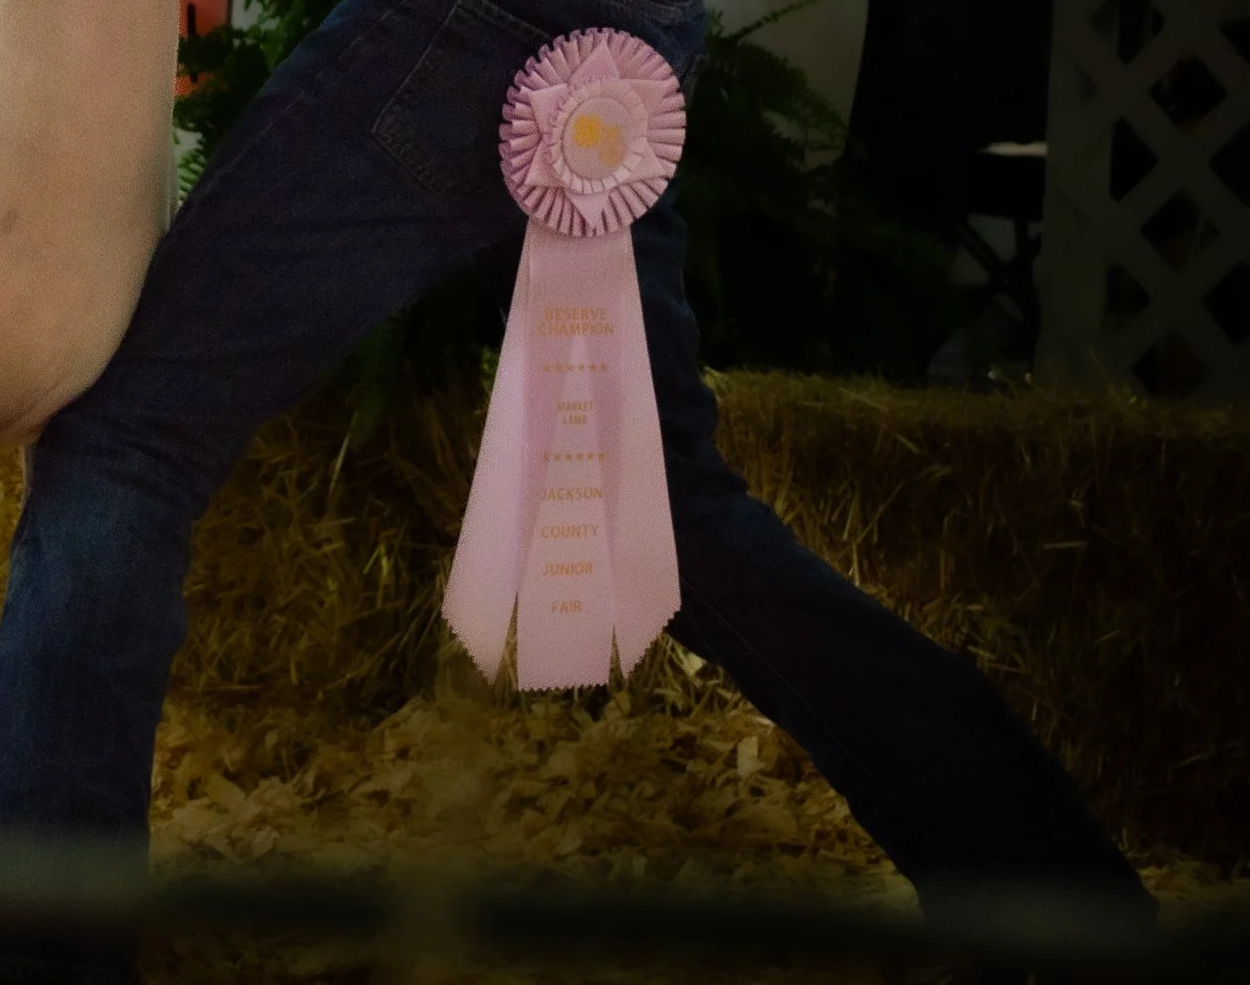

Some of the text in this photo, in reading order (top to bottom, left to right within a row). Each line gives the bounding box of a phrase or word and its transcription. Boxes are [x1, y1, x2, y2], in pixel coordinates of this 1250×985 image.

[544, 307, 607, 321] RESERVE
[536, 322, 614, 336] CHAMPION
[556, 400, 593, 411] MARKET
[562, 414, 588, 425] LAMB
[538, 487, 604, 501] JACKSON
[540, 524, 599, 539] COUNTY
[543, 562, 594, 577] JUNIOR
[550, 600, 583, 614] FAIR
